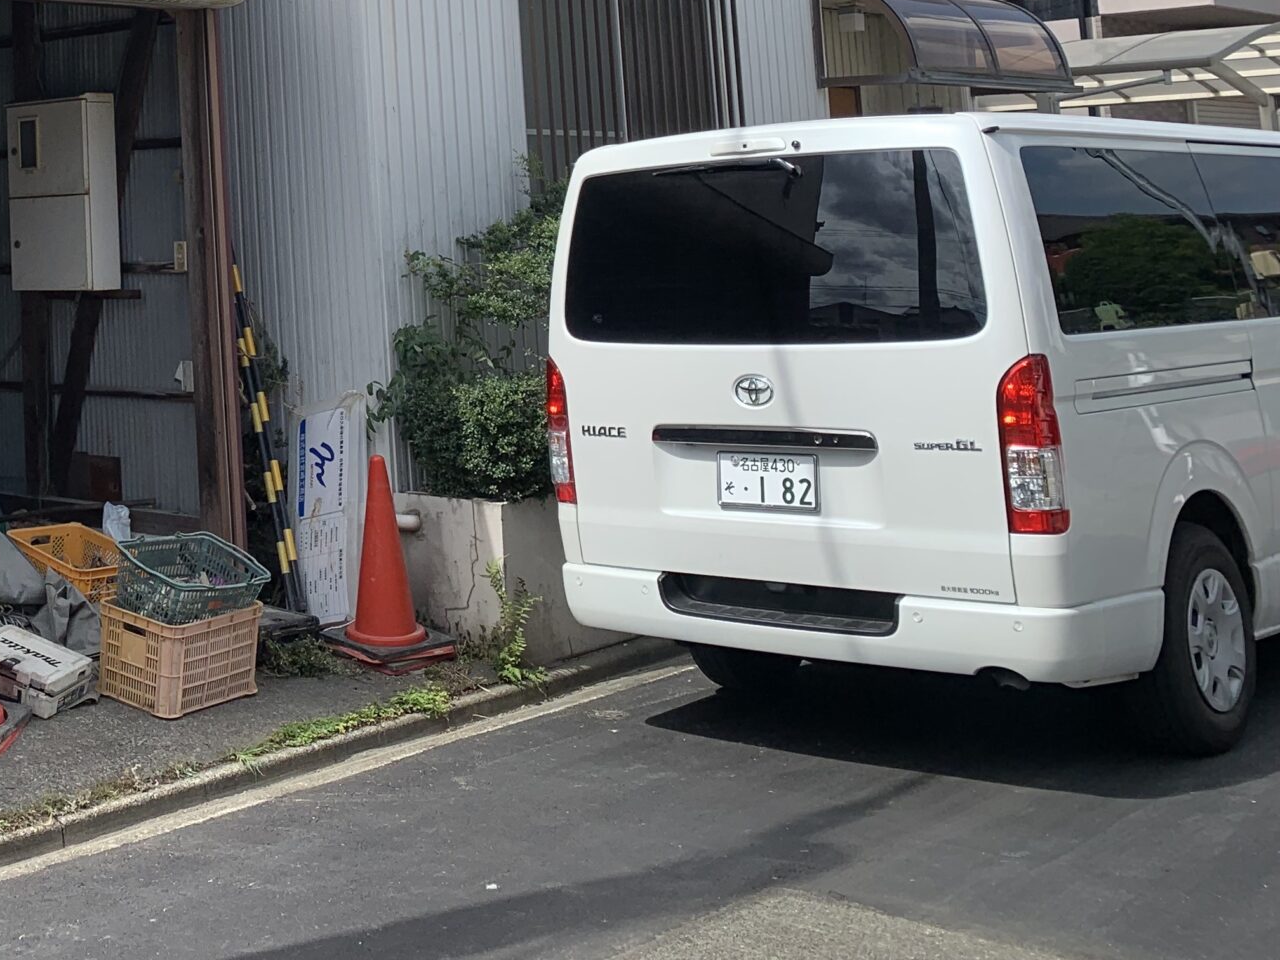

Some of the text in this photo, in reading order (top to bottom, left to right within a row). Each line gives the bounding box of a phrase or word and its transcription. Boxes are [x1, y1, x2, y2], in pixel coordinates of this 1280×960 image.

[581, 425, 627, 439] HIACE
[914, 442, 954, 451] SUPER
[0, 637, 62, 668] makita
